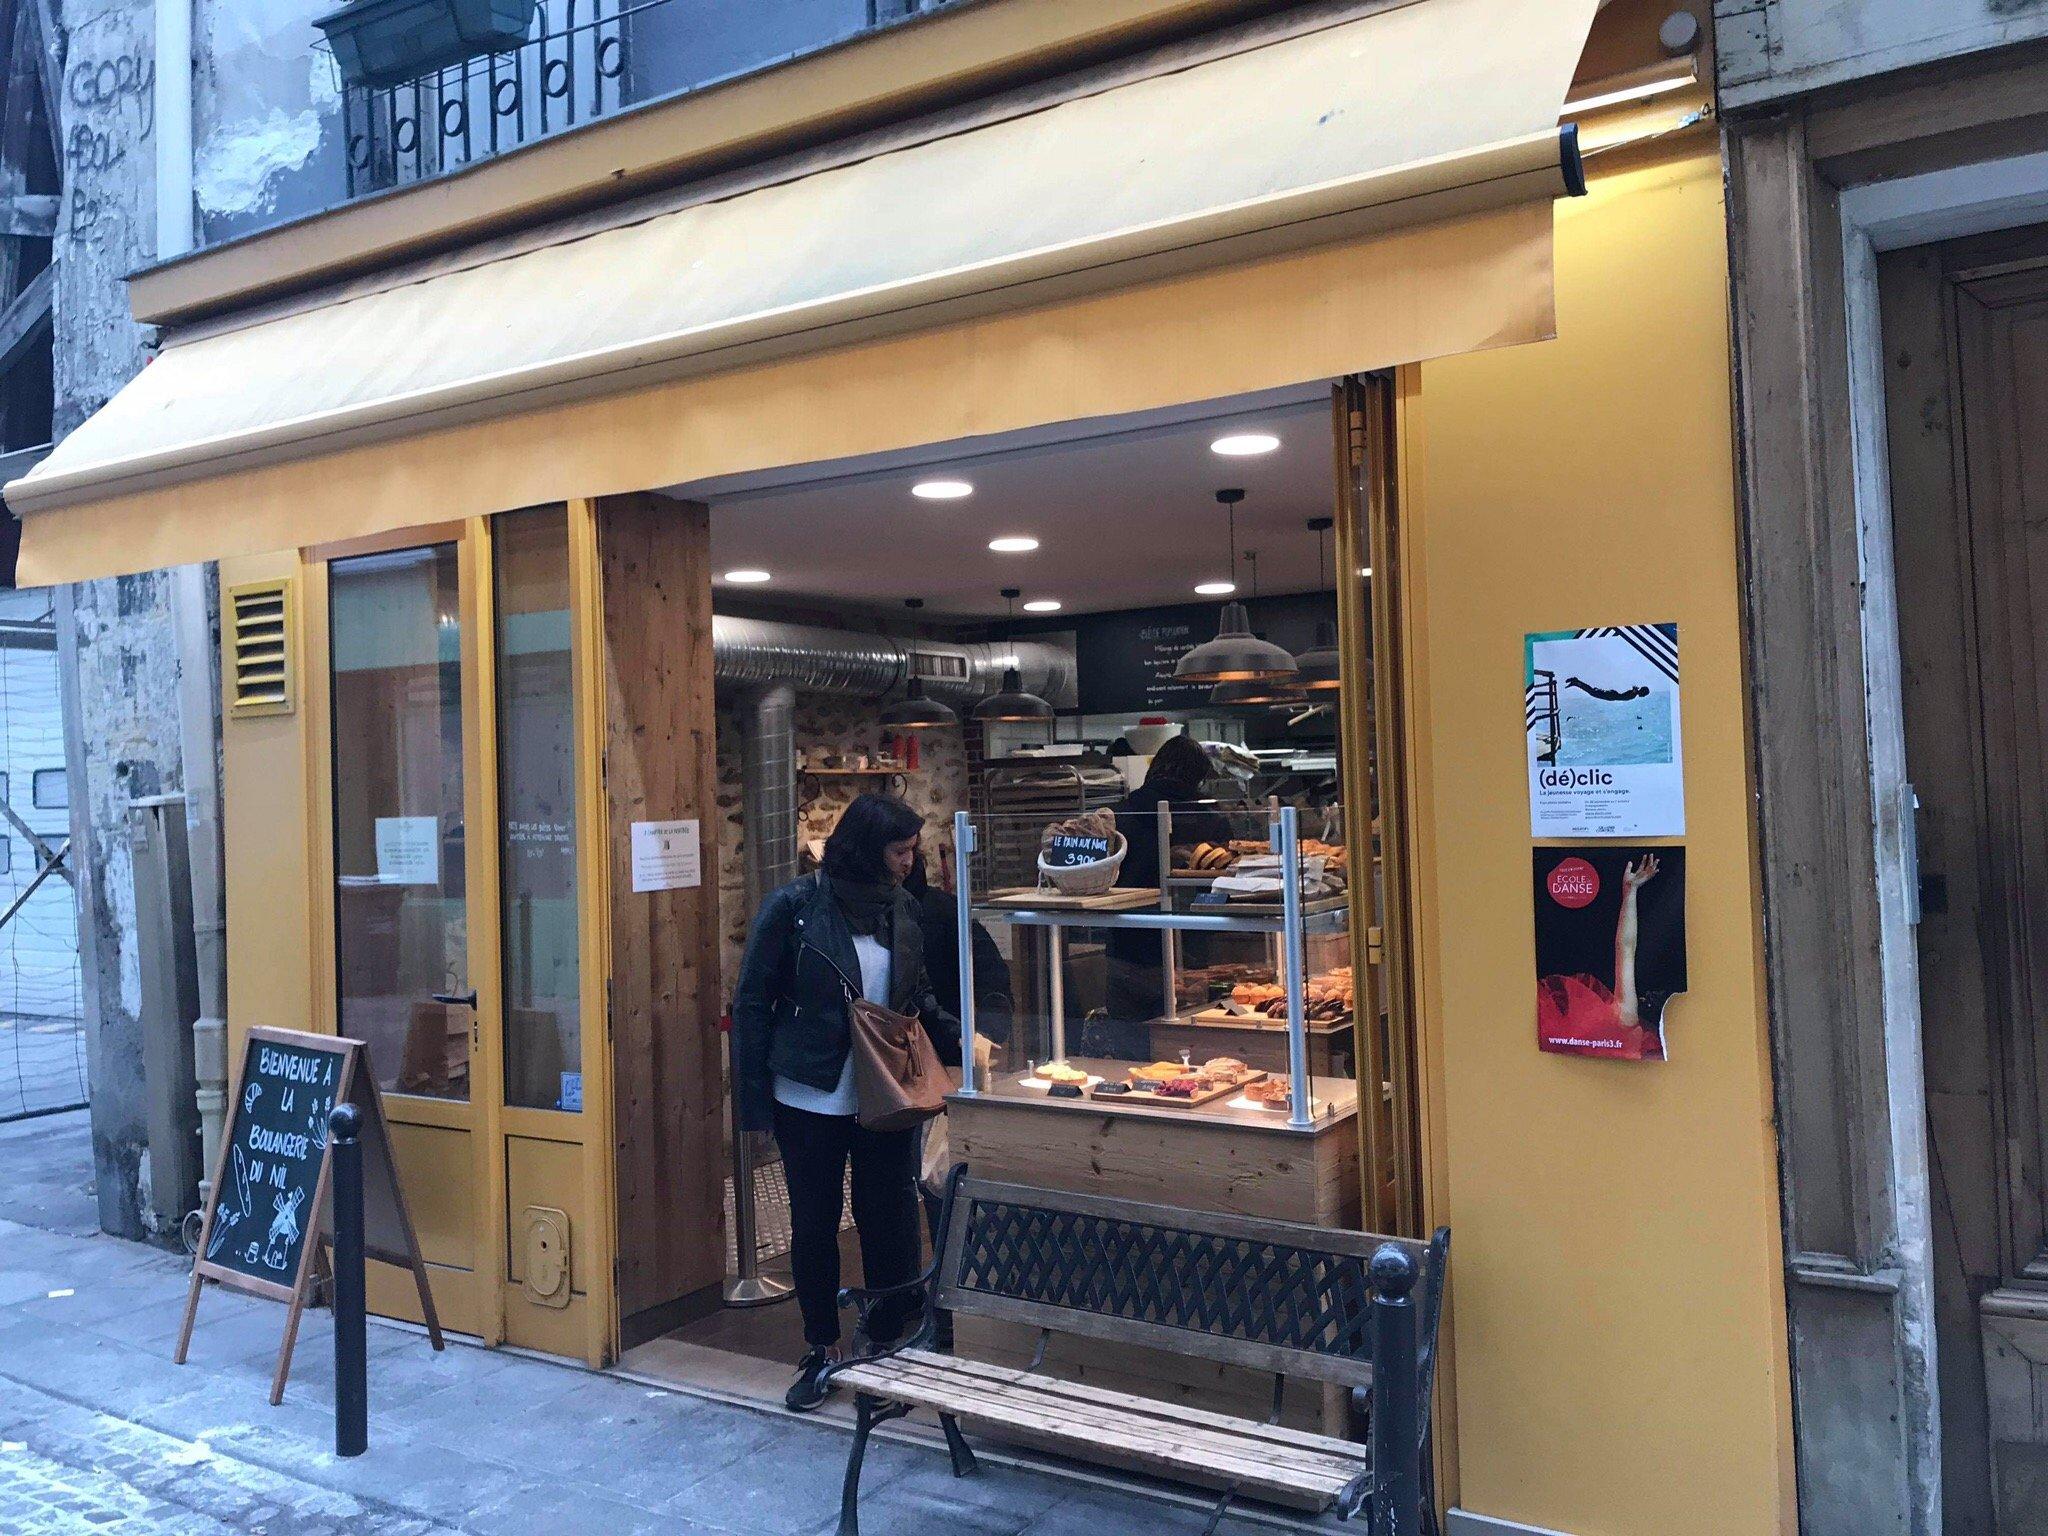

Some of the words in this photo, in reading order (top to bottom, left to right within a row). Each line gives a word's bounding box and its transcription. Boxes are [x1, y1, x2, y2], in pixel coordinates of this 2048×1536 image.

[1540, 768, 1613, 789] (dé)clic
[1054, 835, 1062, 847] LE
[1063, 836, 1078, 848] PAIN
[1079, 837, 1091, 850] AUX
[1552, 883, 1593, 894] DANSE
[1557, 875, 1586, 884] ECOLE
[1548, 1037, 1623, 1048] www.danse-paris3.fr
[260, 1047, 320, 1084] BIENVENUE
[323, 1058, 333, 1086] À
[281, 1086, 294, 1113] LA
[248, 1123, 308, 1160] BOULANGERIE
[249, 1160, 263, 1183] DU
[269, 1163, 287, 1190] NIL
